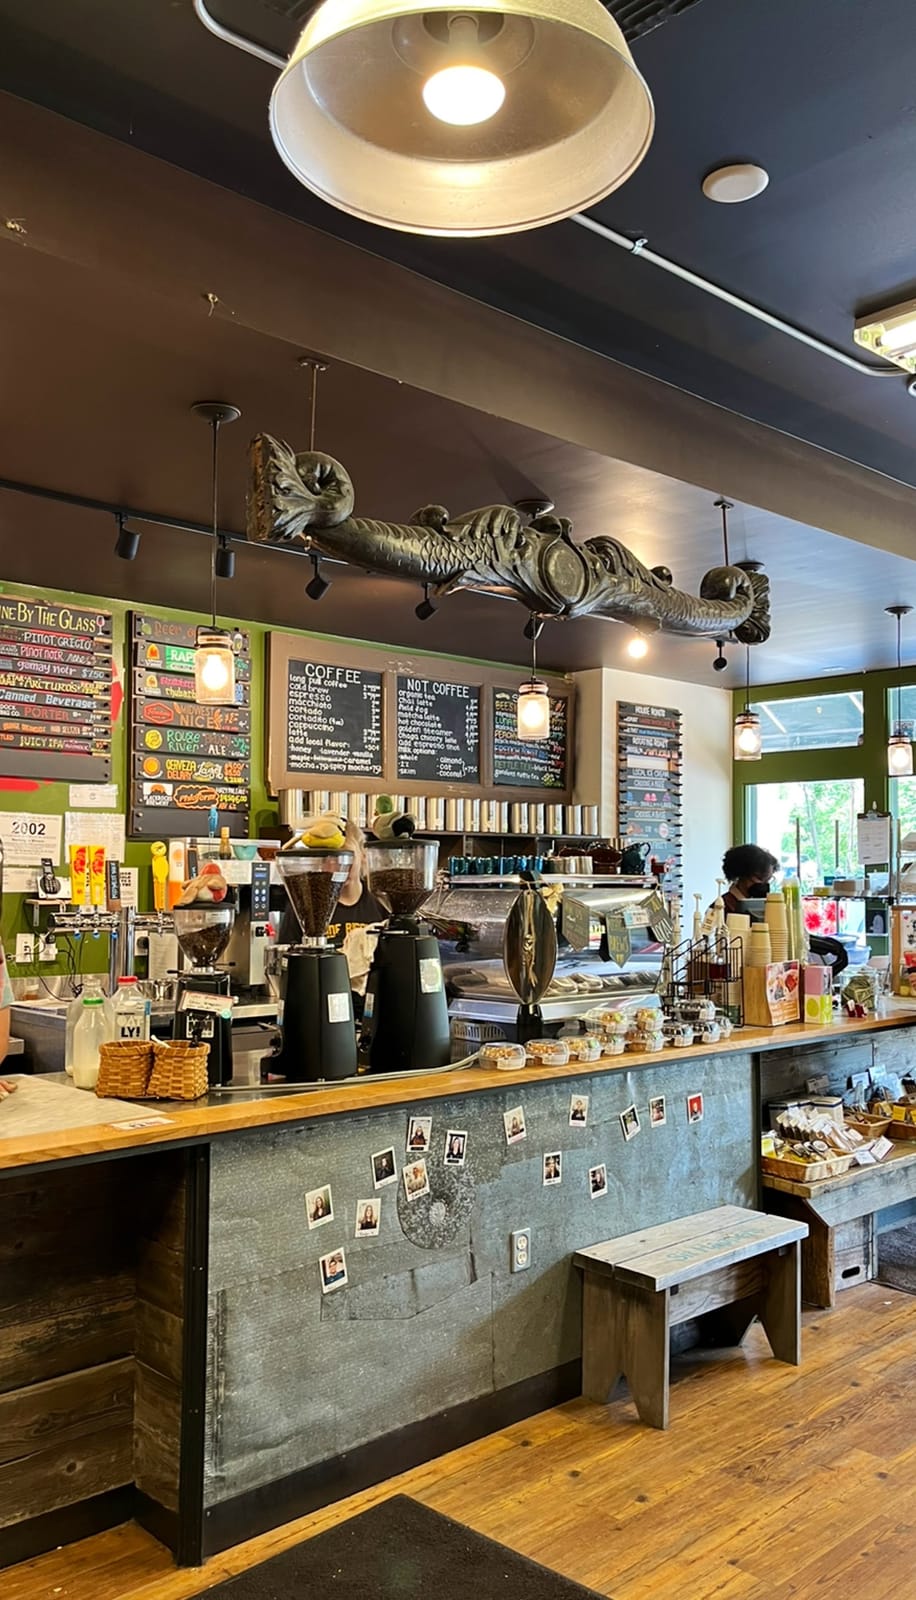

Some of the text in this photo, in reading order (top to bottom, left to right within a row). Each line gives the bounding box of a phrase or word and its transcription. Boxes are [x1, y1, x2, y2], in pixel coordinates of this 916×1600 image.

[305, 664, 361, 684] COFFEE
[324, 680, 347, 688] coffee
[407, 679, 469, 698] NOT COFFEE
[289, 690, 331, 701] espresso
[46, 694, 97, 709] Beverages
[24, 707, 69, 721] PORTER
[410, 720, 441, 728] chocolate
[289, 729, 308, 737] latte
[423, 727, 453, 736] steamer
[12, 822, 46, 836] 2002
[121, 1026, 140, 1037] LY!
